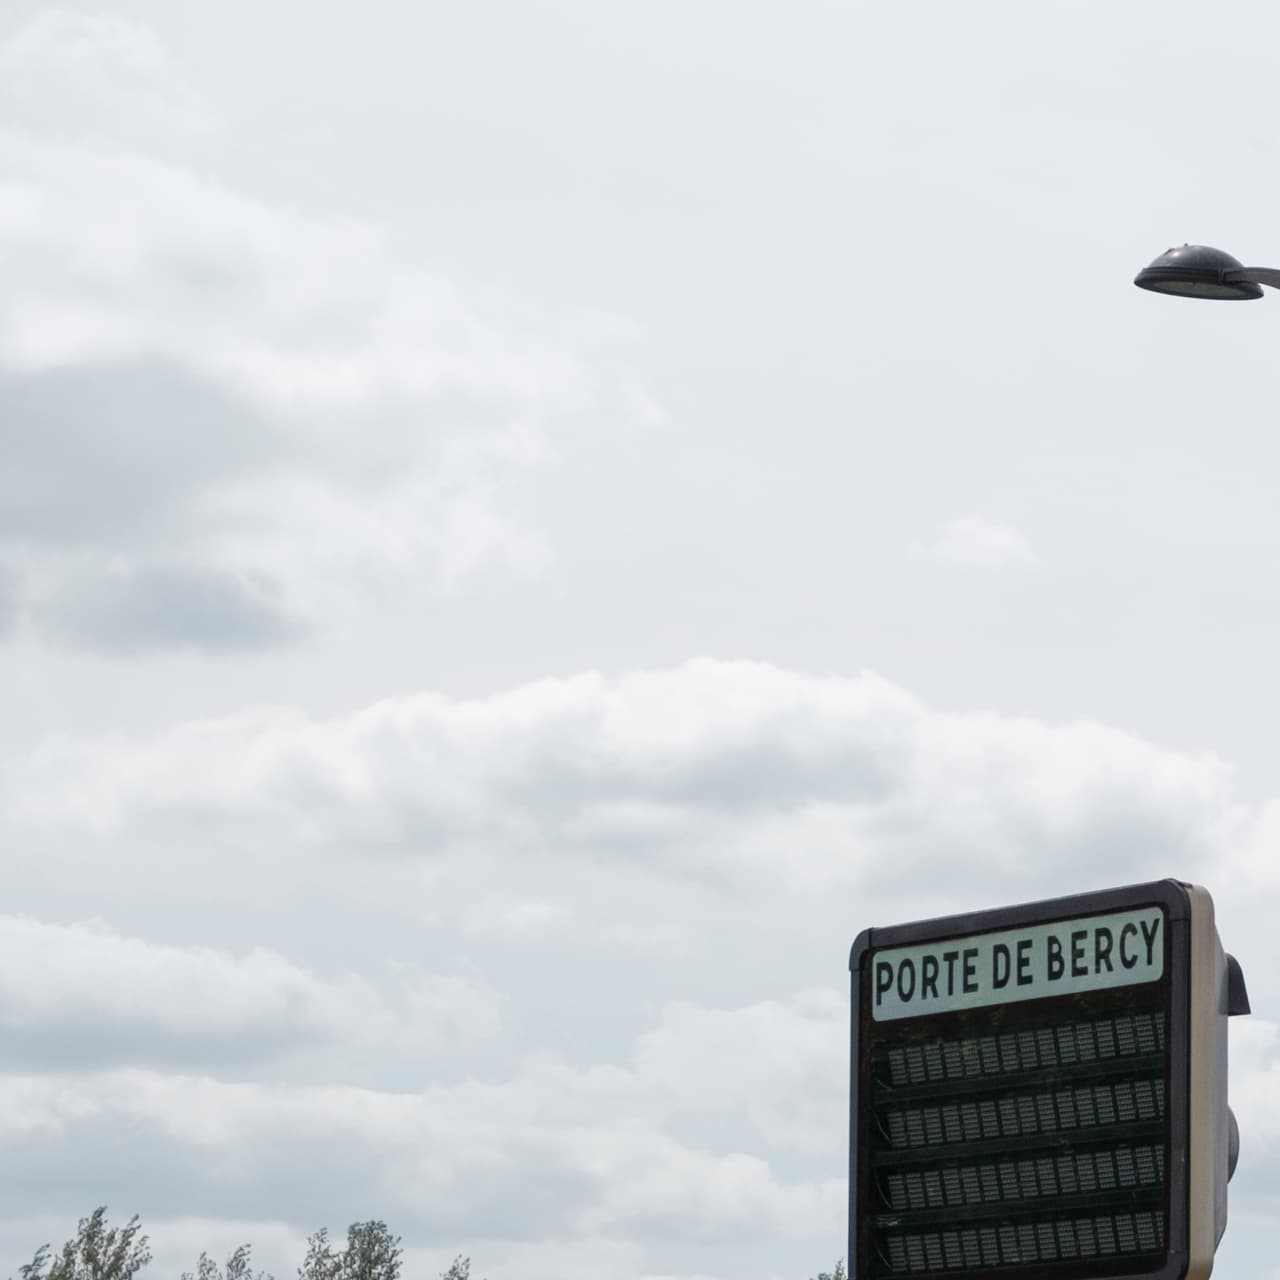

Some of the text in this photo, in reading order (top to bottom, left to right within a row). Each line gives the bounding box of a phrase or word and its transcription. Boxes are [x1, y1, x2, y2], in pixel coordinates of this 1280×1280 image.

[876, 918, 1160, 1005] PORTE DE BERCY
